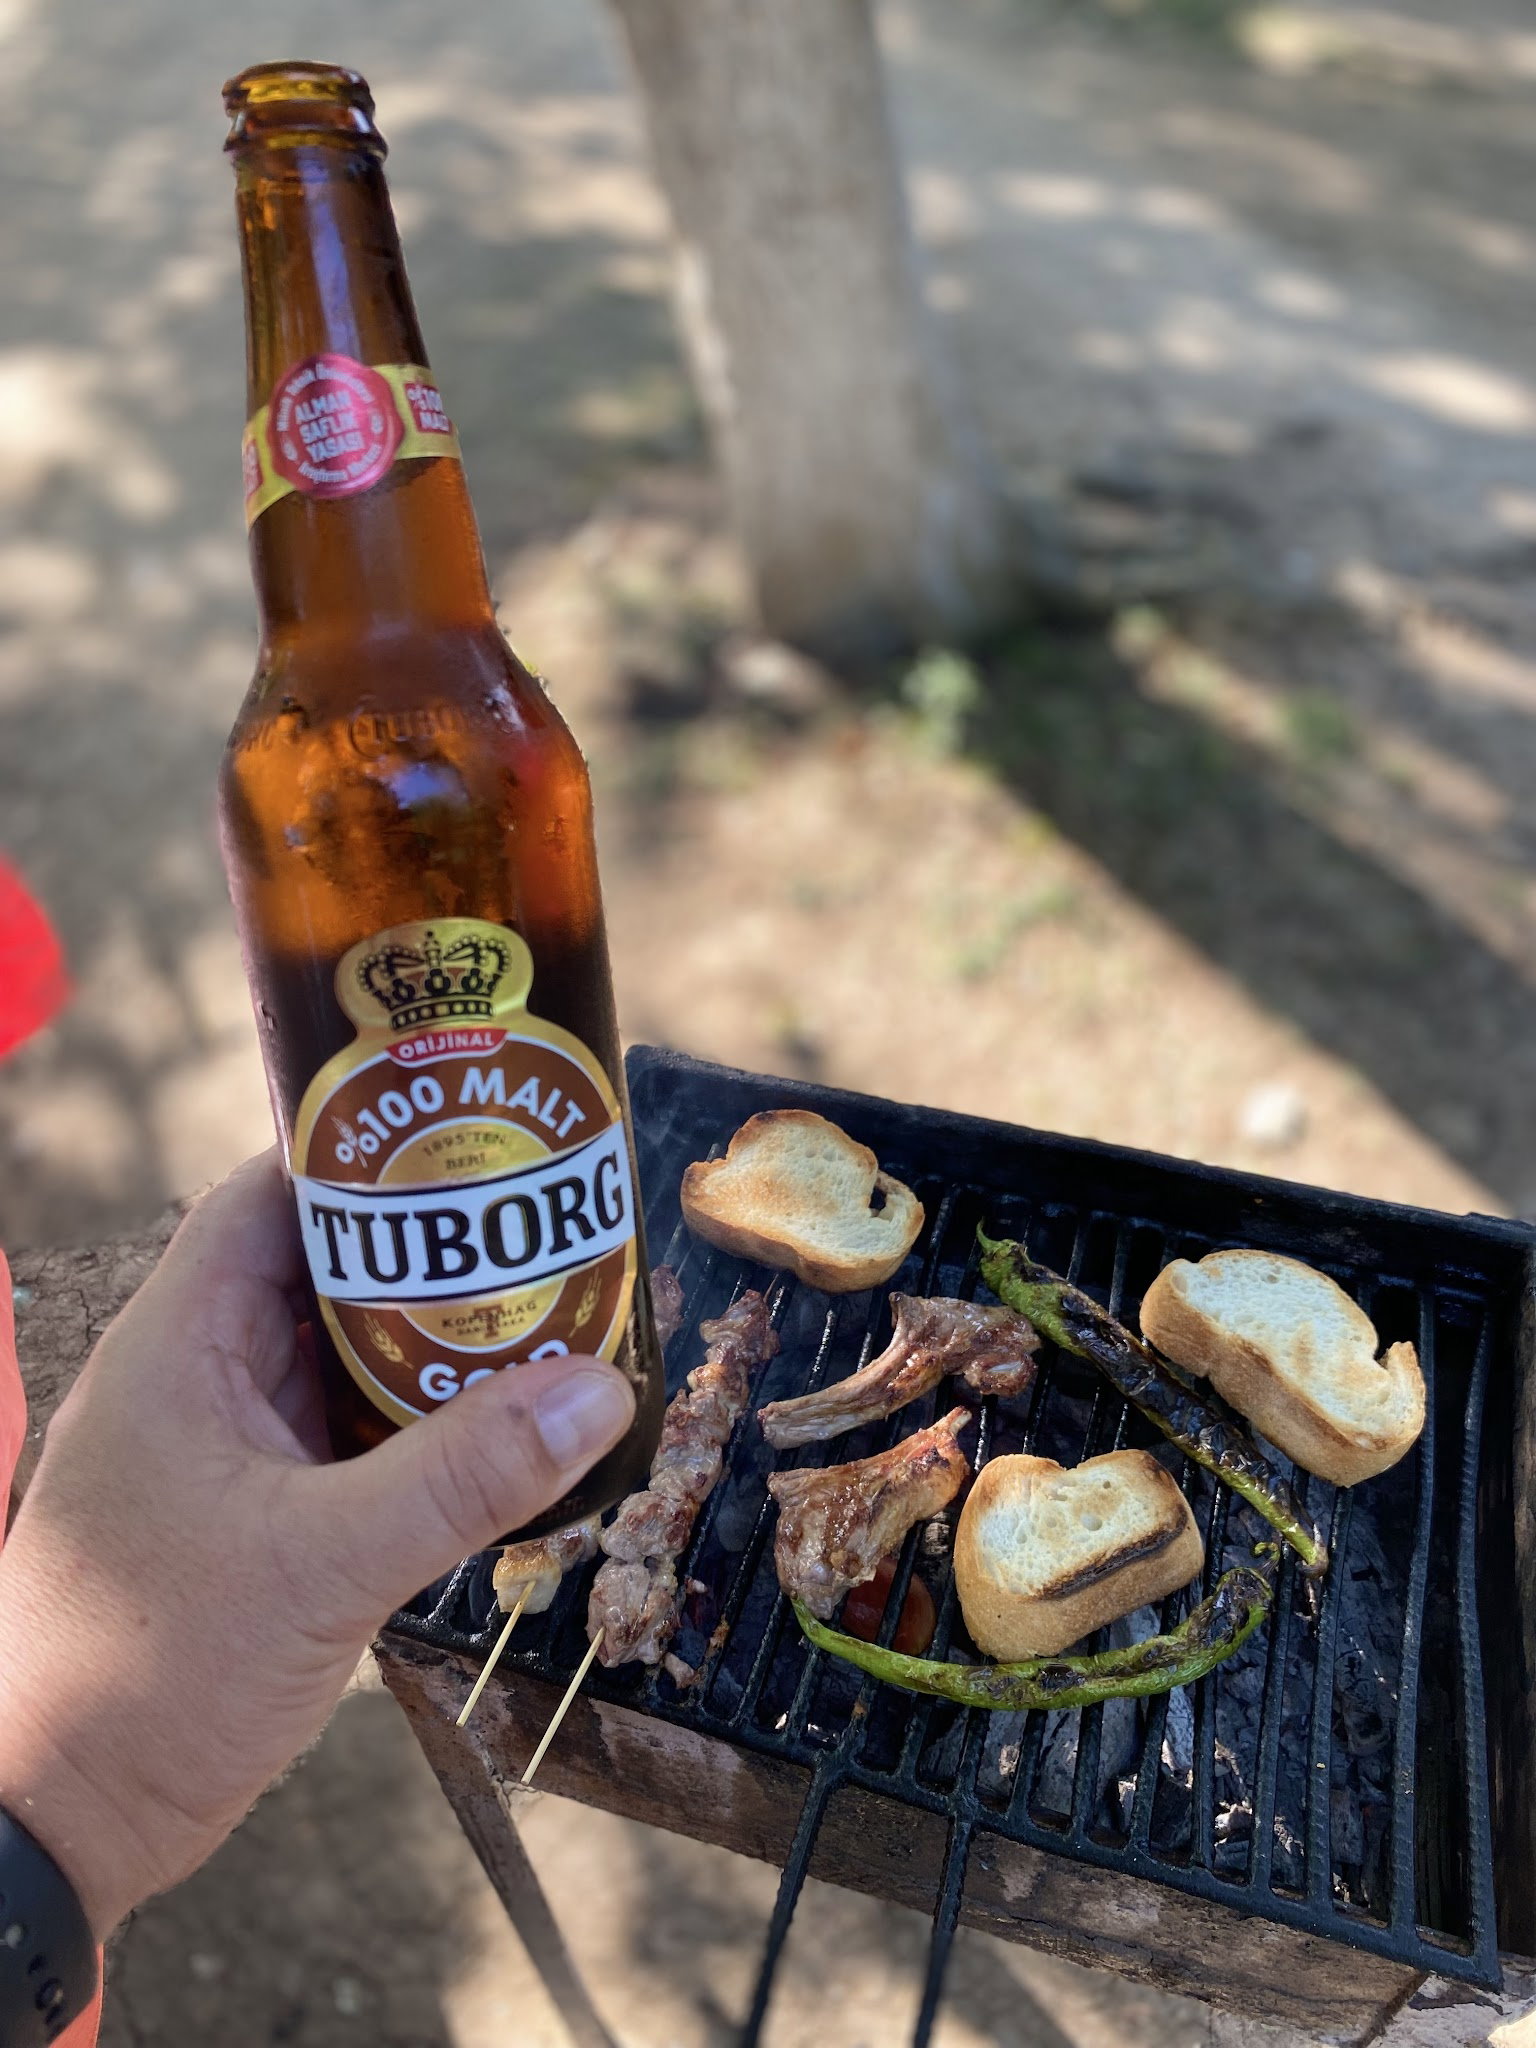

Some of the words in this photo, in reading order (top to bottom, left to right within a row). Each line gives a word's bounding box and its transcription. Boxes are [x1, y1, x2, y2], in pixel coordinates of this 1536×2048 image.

[334, 1075, 445, 1168] %100
[458, 1066, 586, 1139] MALT
[310, 1150, 625, 1284] TUBORG
